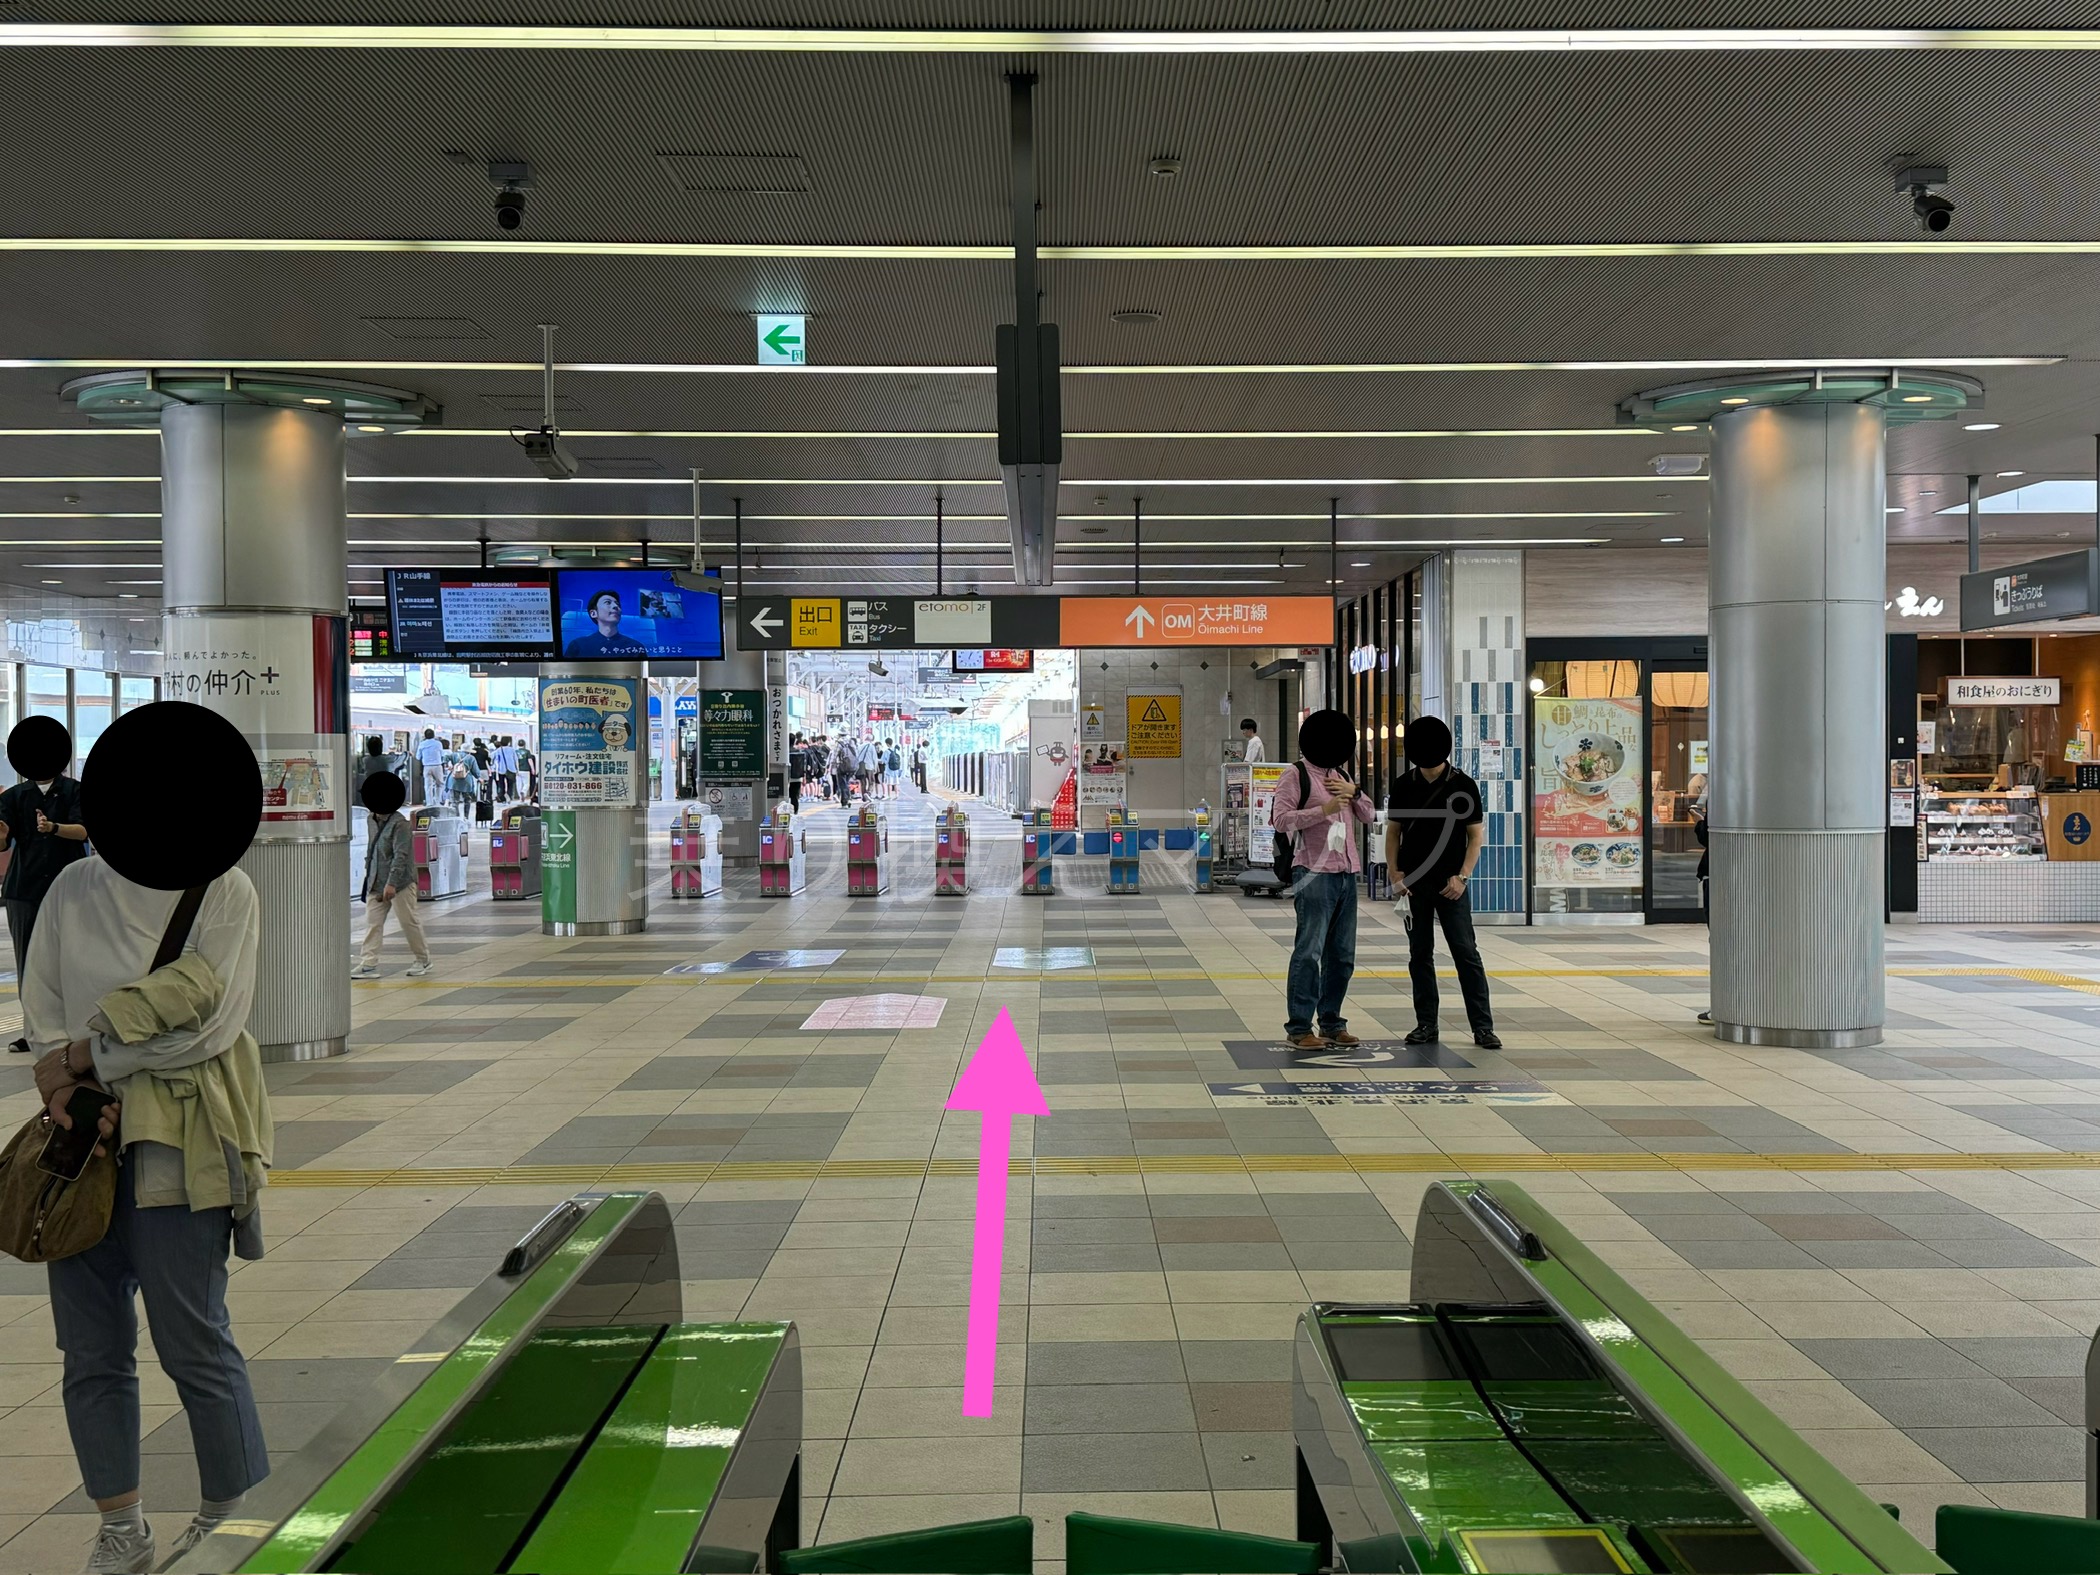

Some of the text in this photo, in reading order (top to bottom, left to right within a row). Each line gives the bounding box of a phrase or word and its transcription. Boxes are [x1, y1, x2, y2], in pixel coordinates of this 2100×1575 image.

[2011, 584, 2043, 602] きっぷうりば
[868, 601, 888, 611] バス
[918, 603, 987, 612] etomo 2F
[799, 605, 833, 624] 出口
[1197, 603, 1268, 622] 大井町線
[1164, 614, 1192, 629] OM
[799, 626, 818, 636] Exit
[868, 623, 907, 634] タクシー
[1197, 623, 1264, 634] Ōimachi Line
[600, 646, 683, 654] 今、やってみたいと思うこと
[1956, 684, 2053, 698] 和食屋のおにぎり
[772, 687, 782, 762] おつかれさまです
[1131, 723, 1177, 731] ドアが開きます
[544, 760, 616, 775] タイホウ建設
[549, 782, 603, 790] 0120-031-866
[762, 834, 773, 845] IC
[938, 834, 949, 844] IC
[1025, 834, 1036, 844] IC
[1298, 1085, 1500, 1093] りんかい線
